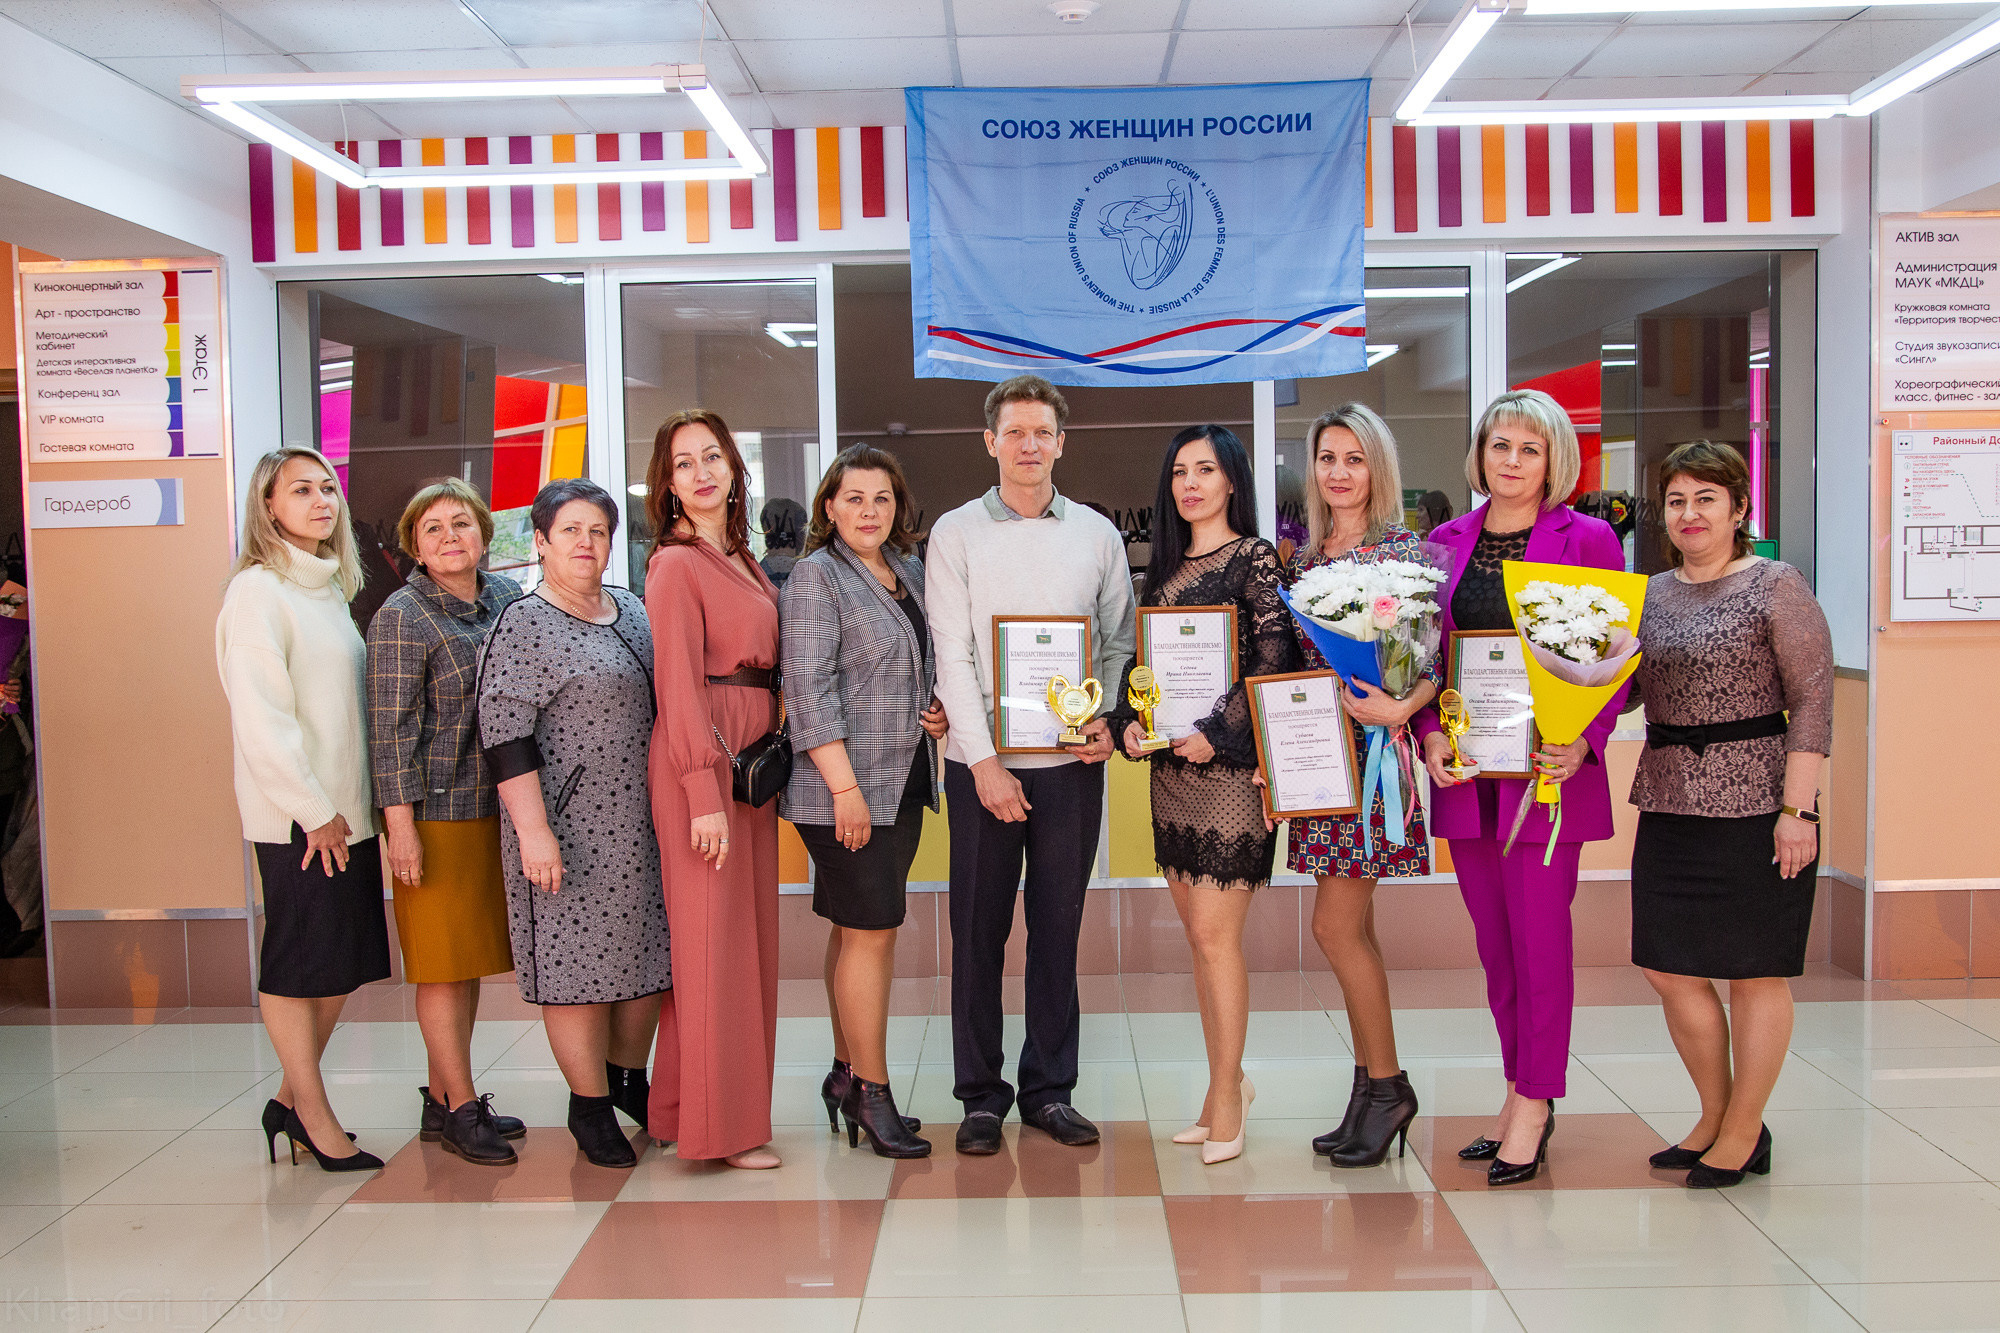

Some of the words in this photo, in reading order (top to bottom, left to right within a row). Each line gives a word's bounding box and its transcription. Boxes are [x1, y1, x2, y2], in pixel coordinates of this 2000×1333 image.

[981, 118, 1061, 140] СОЮЗ
[1068, 117, 1194, 142] ЖЕНЩИН
[1202, 112, 1313, 137] РОССИИ
[1093, 163, 1119, 184] СОЮЗ
[1120, 156, 1163, 168] ЖЕНЩИН
[1164, 158, 1200, 182] РОССИИ
[1205, 188, 1225, 225] L'UNION
[1068, 197, 1086, 230] RUSSIA
[1068, 231, 1077, 244] OF
[1217, 227, 1226, 245] DES
[1895, 231, 1935, 242] АКТИВ
[1937, 233, 1960, 242] зал
[1070, 245, 1086, 276] UNION
[1202, 246, 1224, 283] FEMMES
[1894, 262, 1998, 274] Администрация
[34, 280, 123, 292] Киноконцертный
[125, 282, 144, 290] зал
[1895, 277, 1932, 288] МАУК
[1935, 276, 1984, 288] «МКДЦ»
[1081, 274, 1117, 307] WOMEN'S
[1191, 283, 1204, 296] DE
[1181, 292, 1193, 303] LA
[1118, 301, 1135, 313] THE
[1149, 299, 1182, 314] RUSSIE
[1894, 304, 1947, 314] Кружковая
[1949, 303, 1990, 312] комната
[35, 308, 56, 320] Арт
[64, 308, 141, 320] пространство
[1894, 315, 1956, 326] «Территория
[35, 330, 108, 341] Методический
[36, 342, 76, 351] кабинет
[1894, 341, 1934, 352] Студия
[36, 358, 72, 368] Детская
[74, 357, 136, 366] интерактивная
[192, 334, 208, 380] Этаж
[1894, 354, 1936, 364] «Сингл»
[36, 369, 72, 377] комната
[38, 388, 100, 400] Конференц
[102, 389, 120, 397] зал
[1894, 394, 1932, 402] класс,
[1934, 392, 1974, 403] фитнес
[38, 414, 57, 424] VIP
[59, 415, 104, 424] комната
[1932, 436, 1986, 446] Районный
[39, 442, 87, 453] Гостевая
[89, 442, 135, 452] комната
[44, 495, 131, 515] Гардероб
